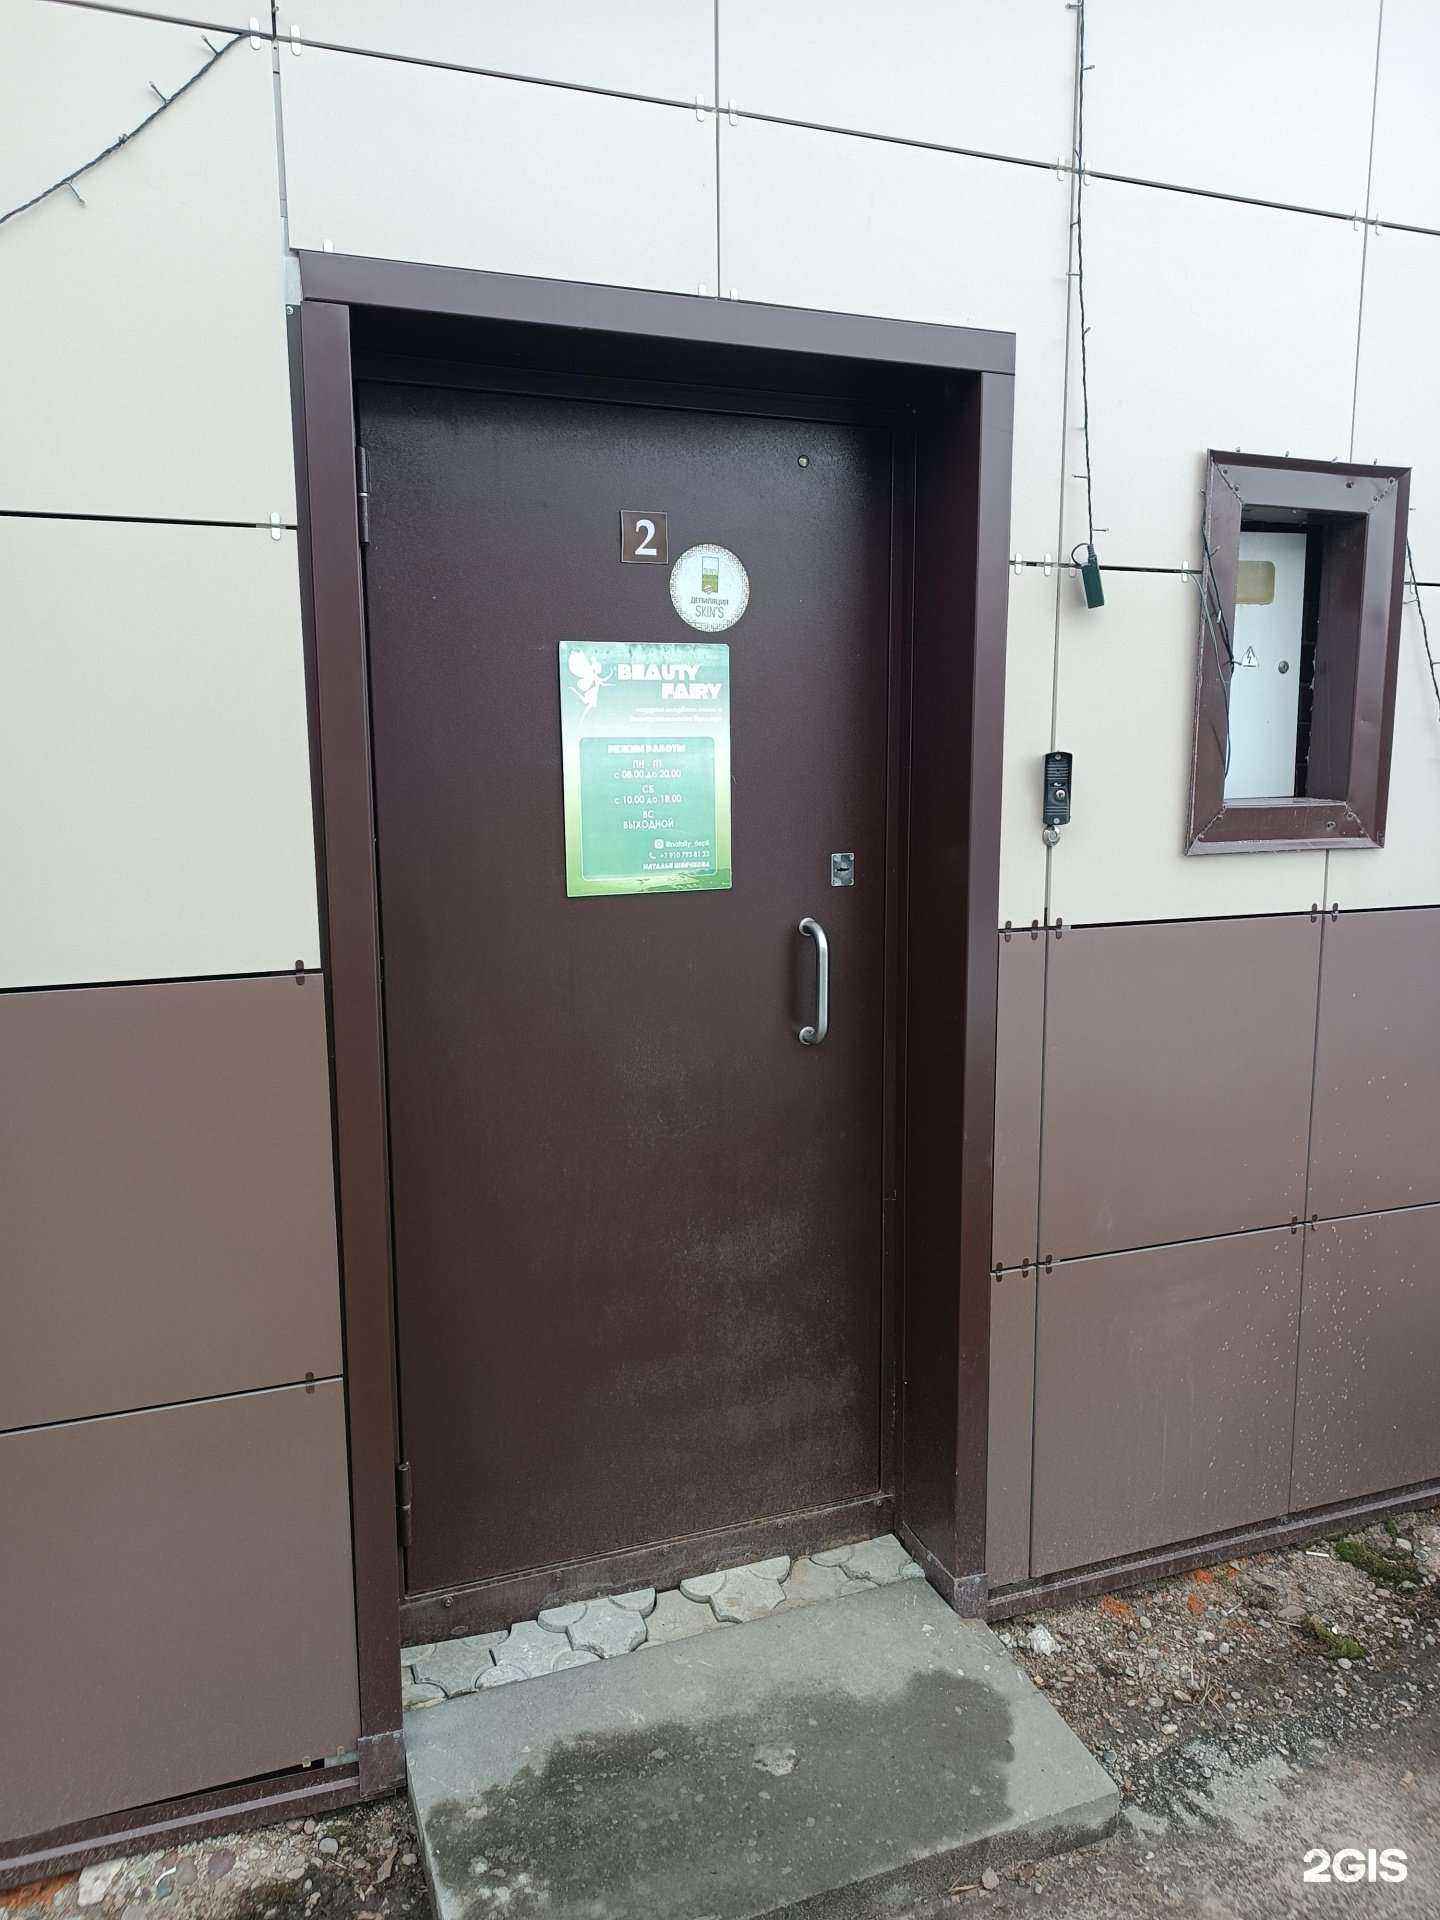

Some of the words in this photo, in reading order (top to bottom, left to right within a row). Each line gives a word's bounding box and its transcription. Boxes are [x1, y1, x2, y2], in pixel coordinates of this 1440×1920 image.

[634, 519, 657, 556] 2
[617, 663, 702, 681] BEAUTY
[661, 682, 722, 700] FAIRY
[641, 784, 655, 794] СБ
[623, 817, 674, 830] ВЫХОДНОЙ
